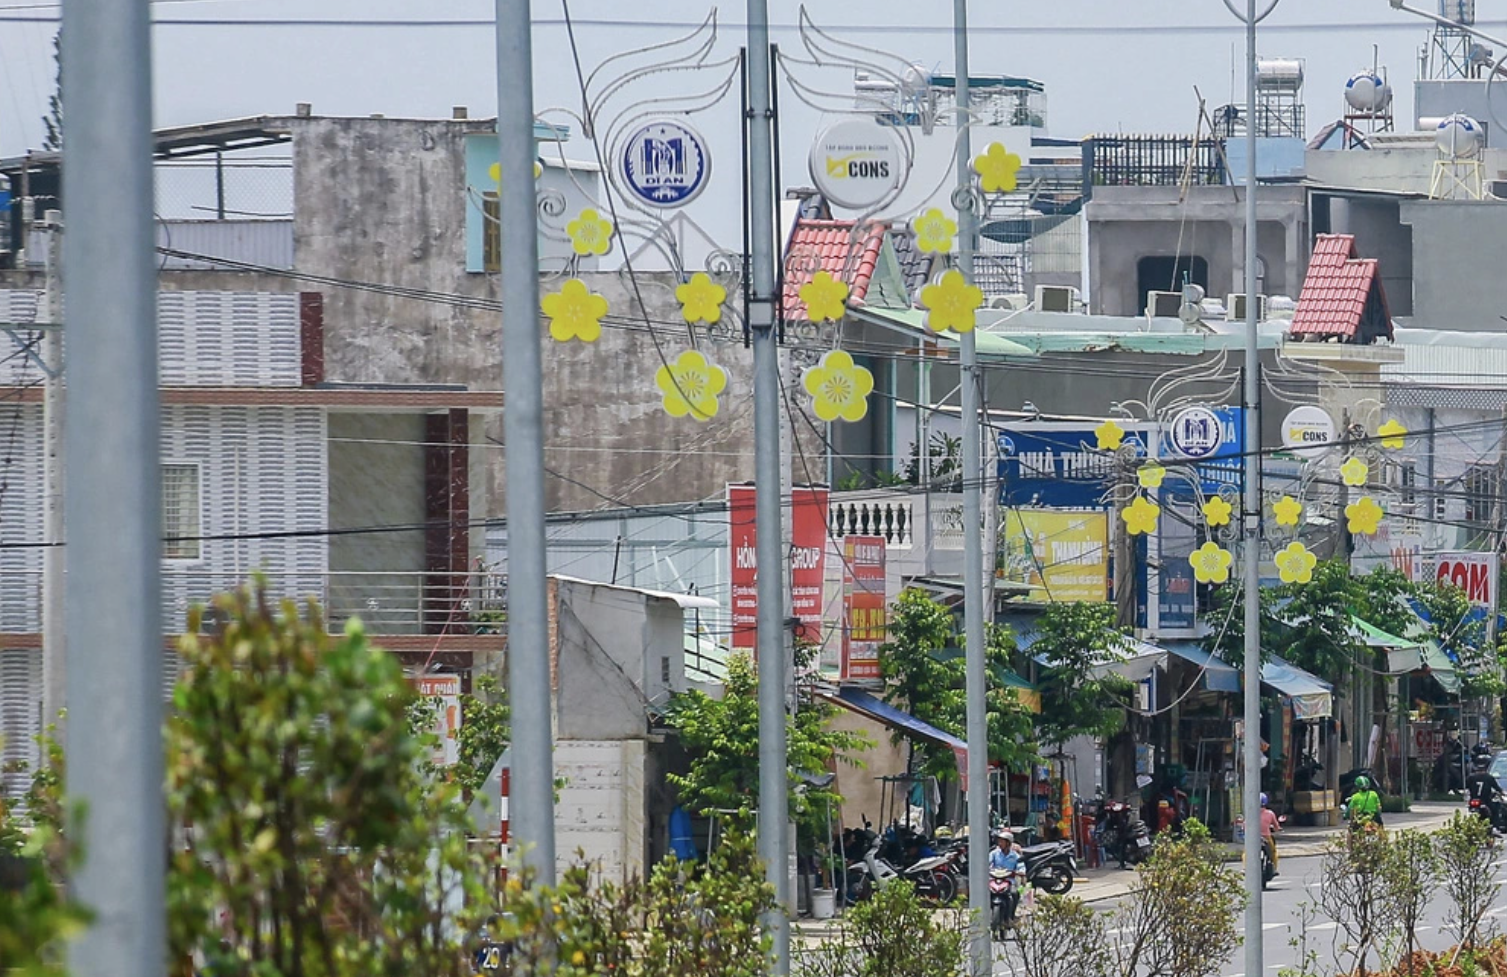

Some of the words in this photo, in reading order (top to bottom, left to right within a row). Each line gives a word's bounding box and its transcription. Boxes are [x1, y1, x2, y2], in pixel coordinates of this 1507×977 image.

[664, 176, 684, 184] AN
[1018, 446, 1057, 478] NHÀ
[1476, 781, 1484, 796] 7
